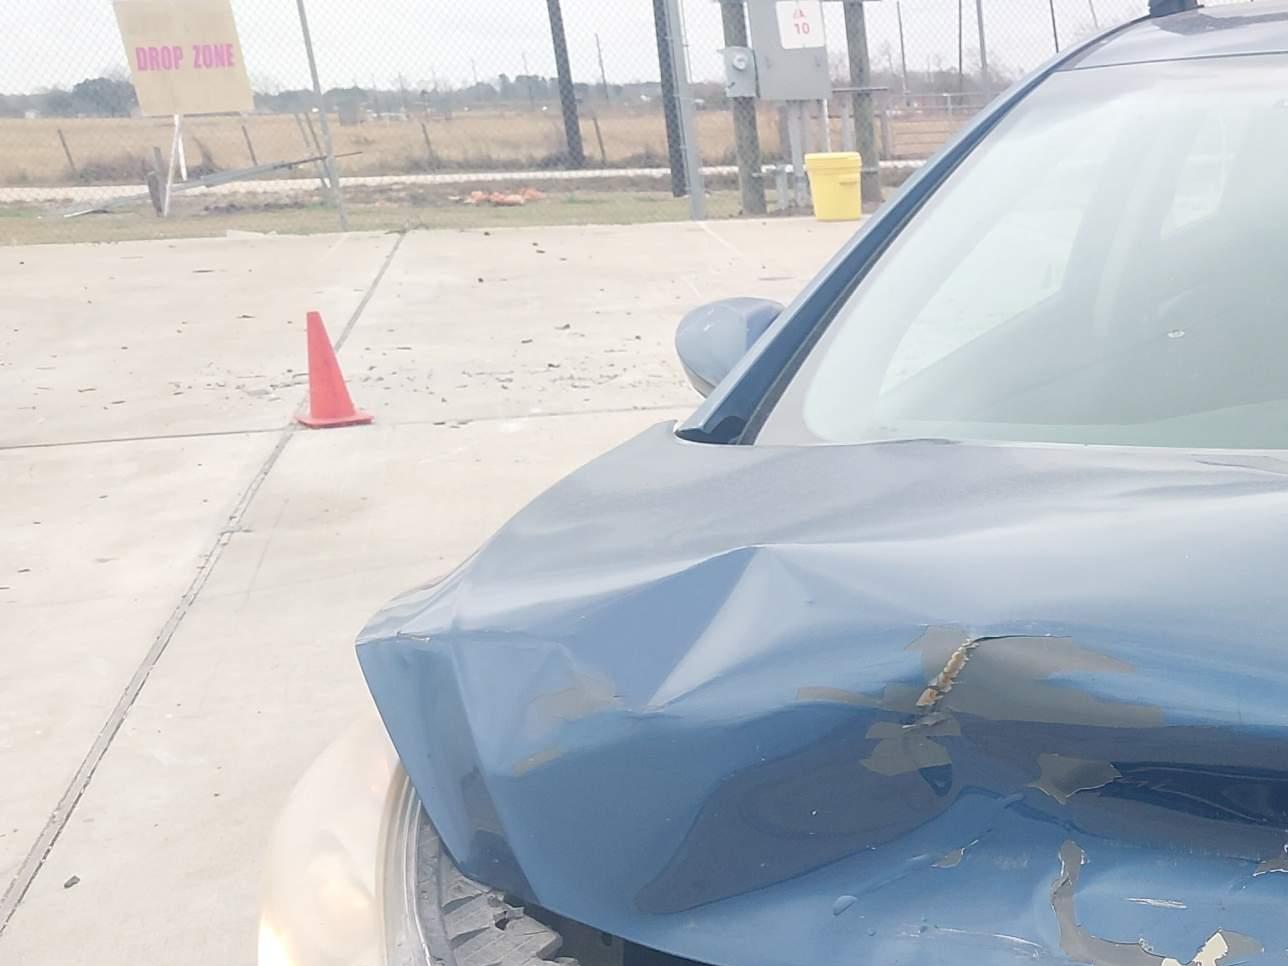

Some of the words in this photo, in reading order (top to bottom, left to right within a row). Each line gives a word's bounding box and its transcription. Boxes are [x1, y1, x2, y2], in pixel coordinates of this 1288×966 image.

[794, 22, 810, 35] 10
[135, 46, 184, 72] DROP
[191, 43, 236, 69] ZONE
